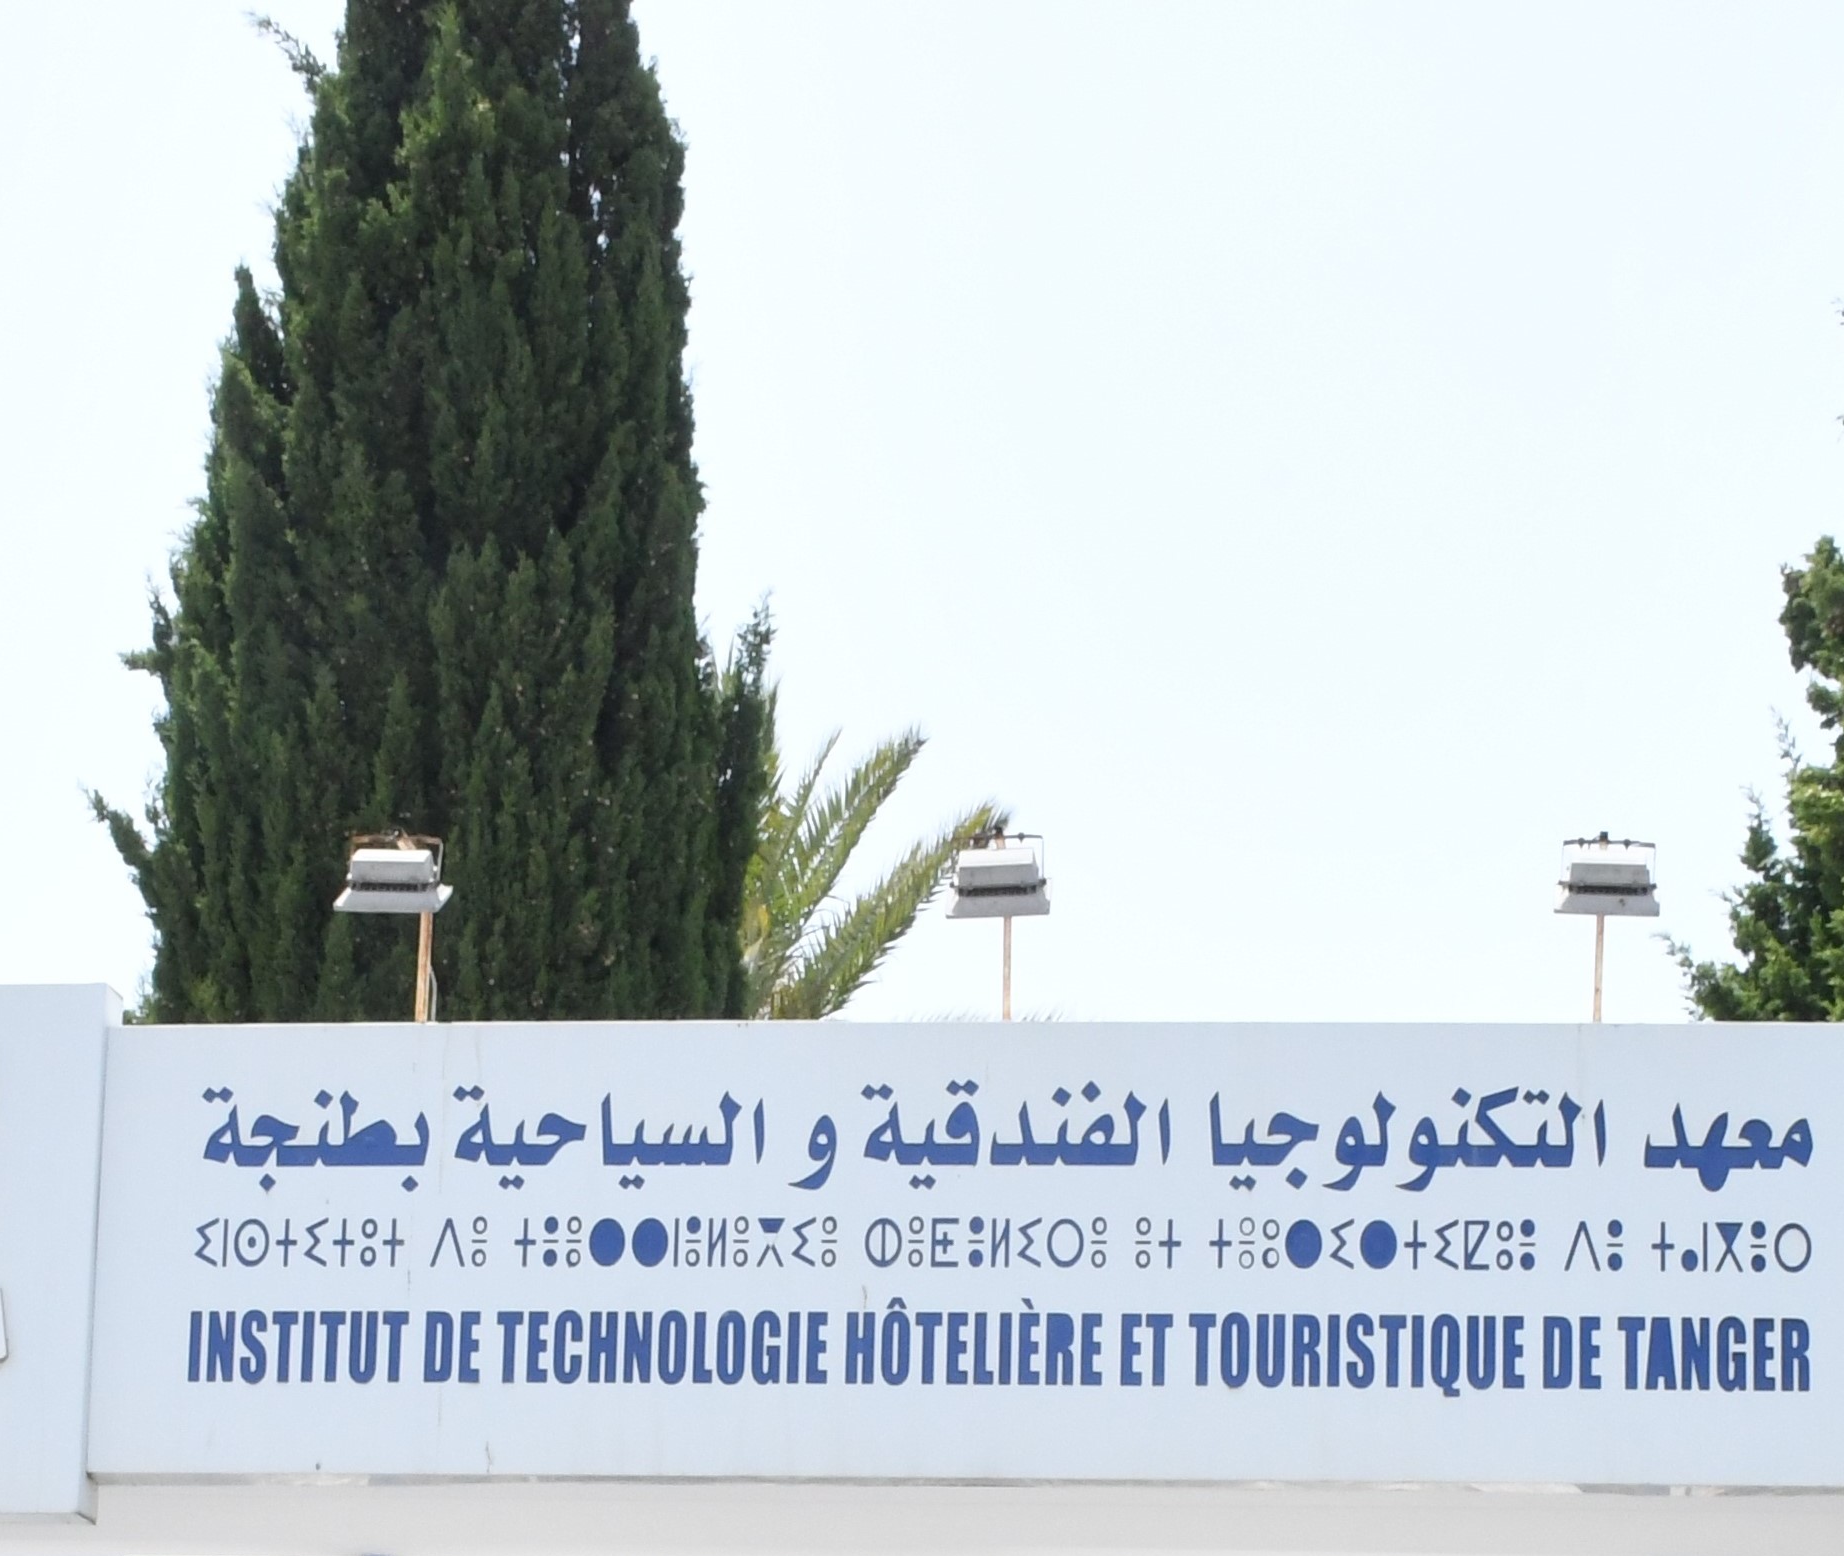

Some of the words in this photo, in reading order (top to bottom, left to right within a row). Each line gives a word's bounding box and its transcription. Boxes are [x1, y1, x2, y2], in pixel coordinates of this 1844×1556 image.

[202, 1087, 429, 1193] بطنجة
[453, 1085, 764, 1190] السياحية
[788, 1115, 837, 1190] و
[861, 1079, 1170, 1189] الفندقية
[1210, 1086, 1606, 1192] التكنولوجيا
[1644, 1103, 1813, 1192] معهد
[188, 1309, 409, 1385] INSTITUT
[423, 1311, 481, 1384] DE
[497, 1310, 828, 1385] TECHNOLOGIE
[845, 1295, 1102, 1386] HÔTELIÈRE
[1120, 1313, 1173, 1386] ET
[1189, 1312, 1525, 1397] TOURISTIQUE
[1543, 1316, 1602, 1390] DE
[1617, 1316, 1810, 1392] TANGER
